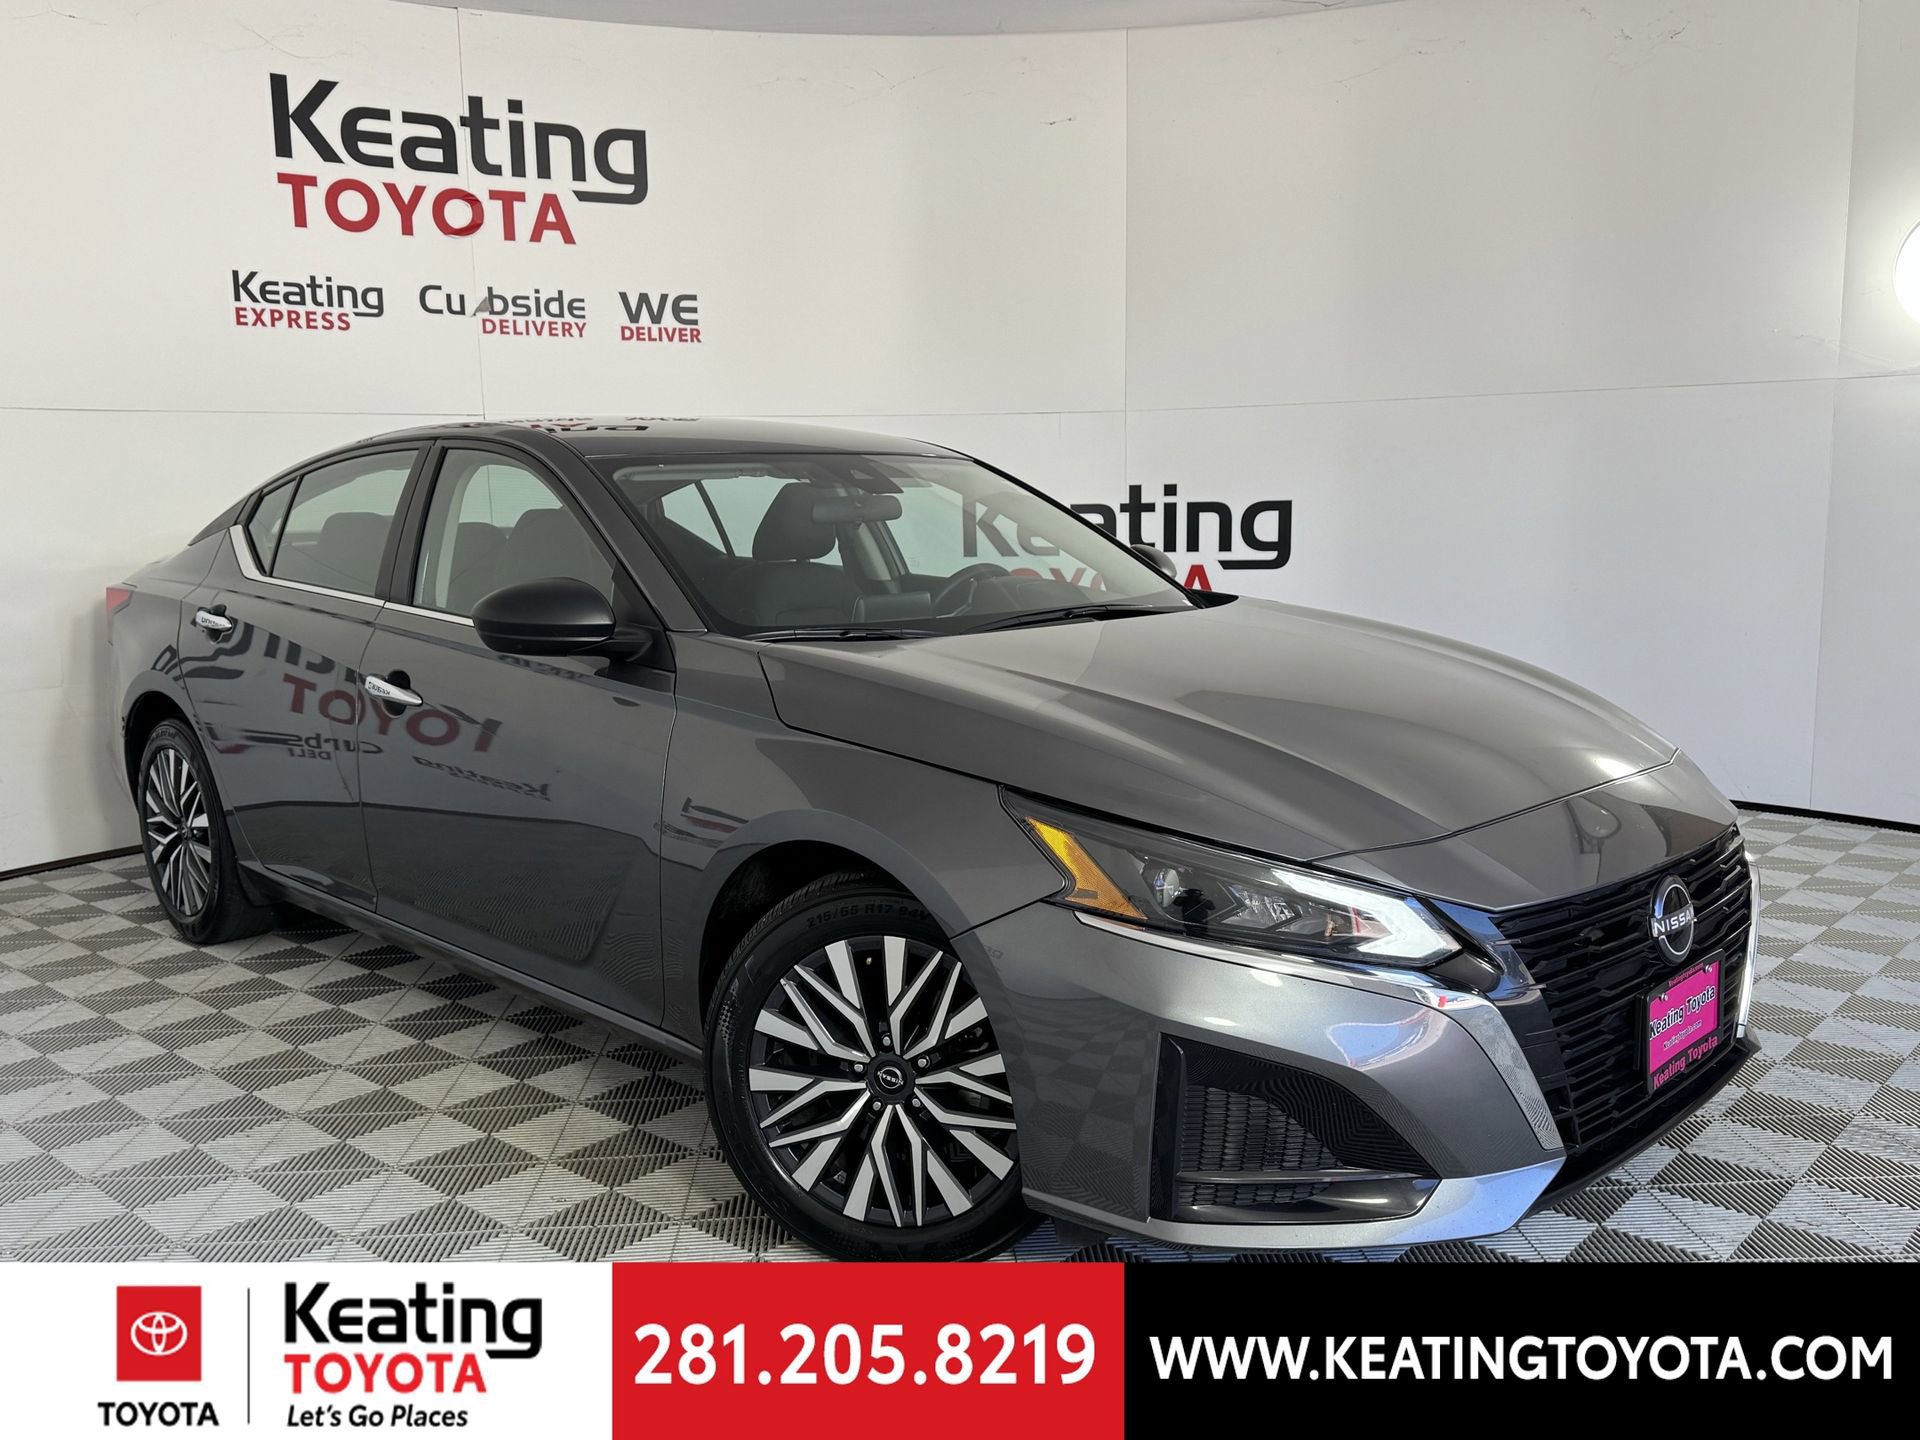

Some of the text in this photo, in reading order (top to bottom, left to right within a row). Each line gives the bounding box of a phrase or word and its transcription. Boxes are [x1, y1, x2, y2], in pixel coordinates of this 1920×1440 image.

[270, 73, 648, 204] Keating
[277, 172, 576, 245] TOYOTA
[232, 270, 383, 317] Keating
[420, 286, 585, 318] Cubside
[619, 292, 698, 325] WE
[236, 307, 350, 331] EXPRESS
[482, 316, 587, 339] DELIVERY
[622, 325, 701, 342] DELIVER
[1650, 986, 1716, 1040] Keating Toyota
[1653, 1036, 1718, 1089] Keating Toyota
